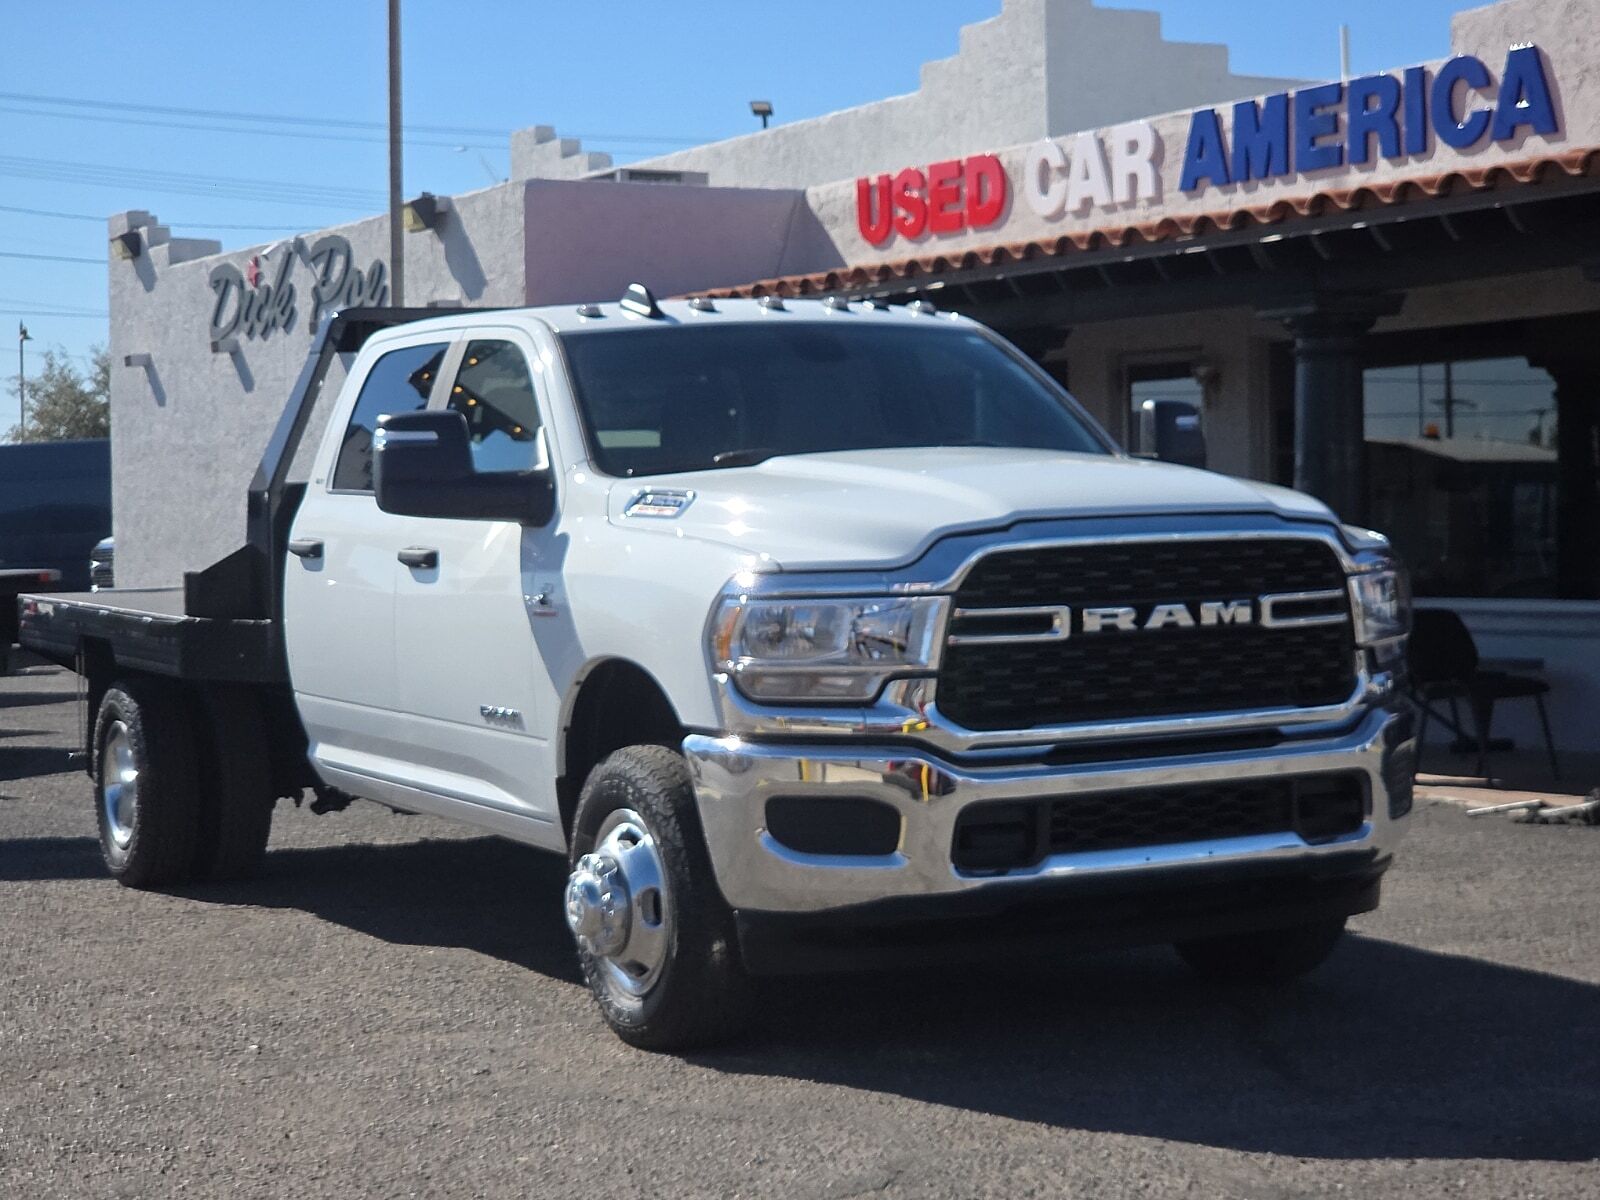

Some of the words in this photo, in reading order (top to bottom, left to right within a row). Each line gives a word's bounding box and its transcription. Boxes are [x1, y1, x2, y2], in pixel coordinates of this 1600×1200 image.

[857, 155, 1006, 245] USED
[1025, 120, 1163, 219] CAR
[1180, 44, 1558, 193] AMERICA
[210, 243, 297, 341] Dick
[1083, 601, 1252, 632] RAM
